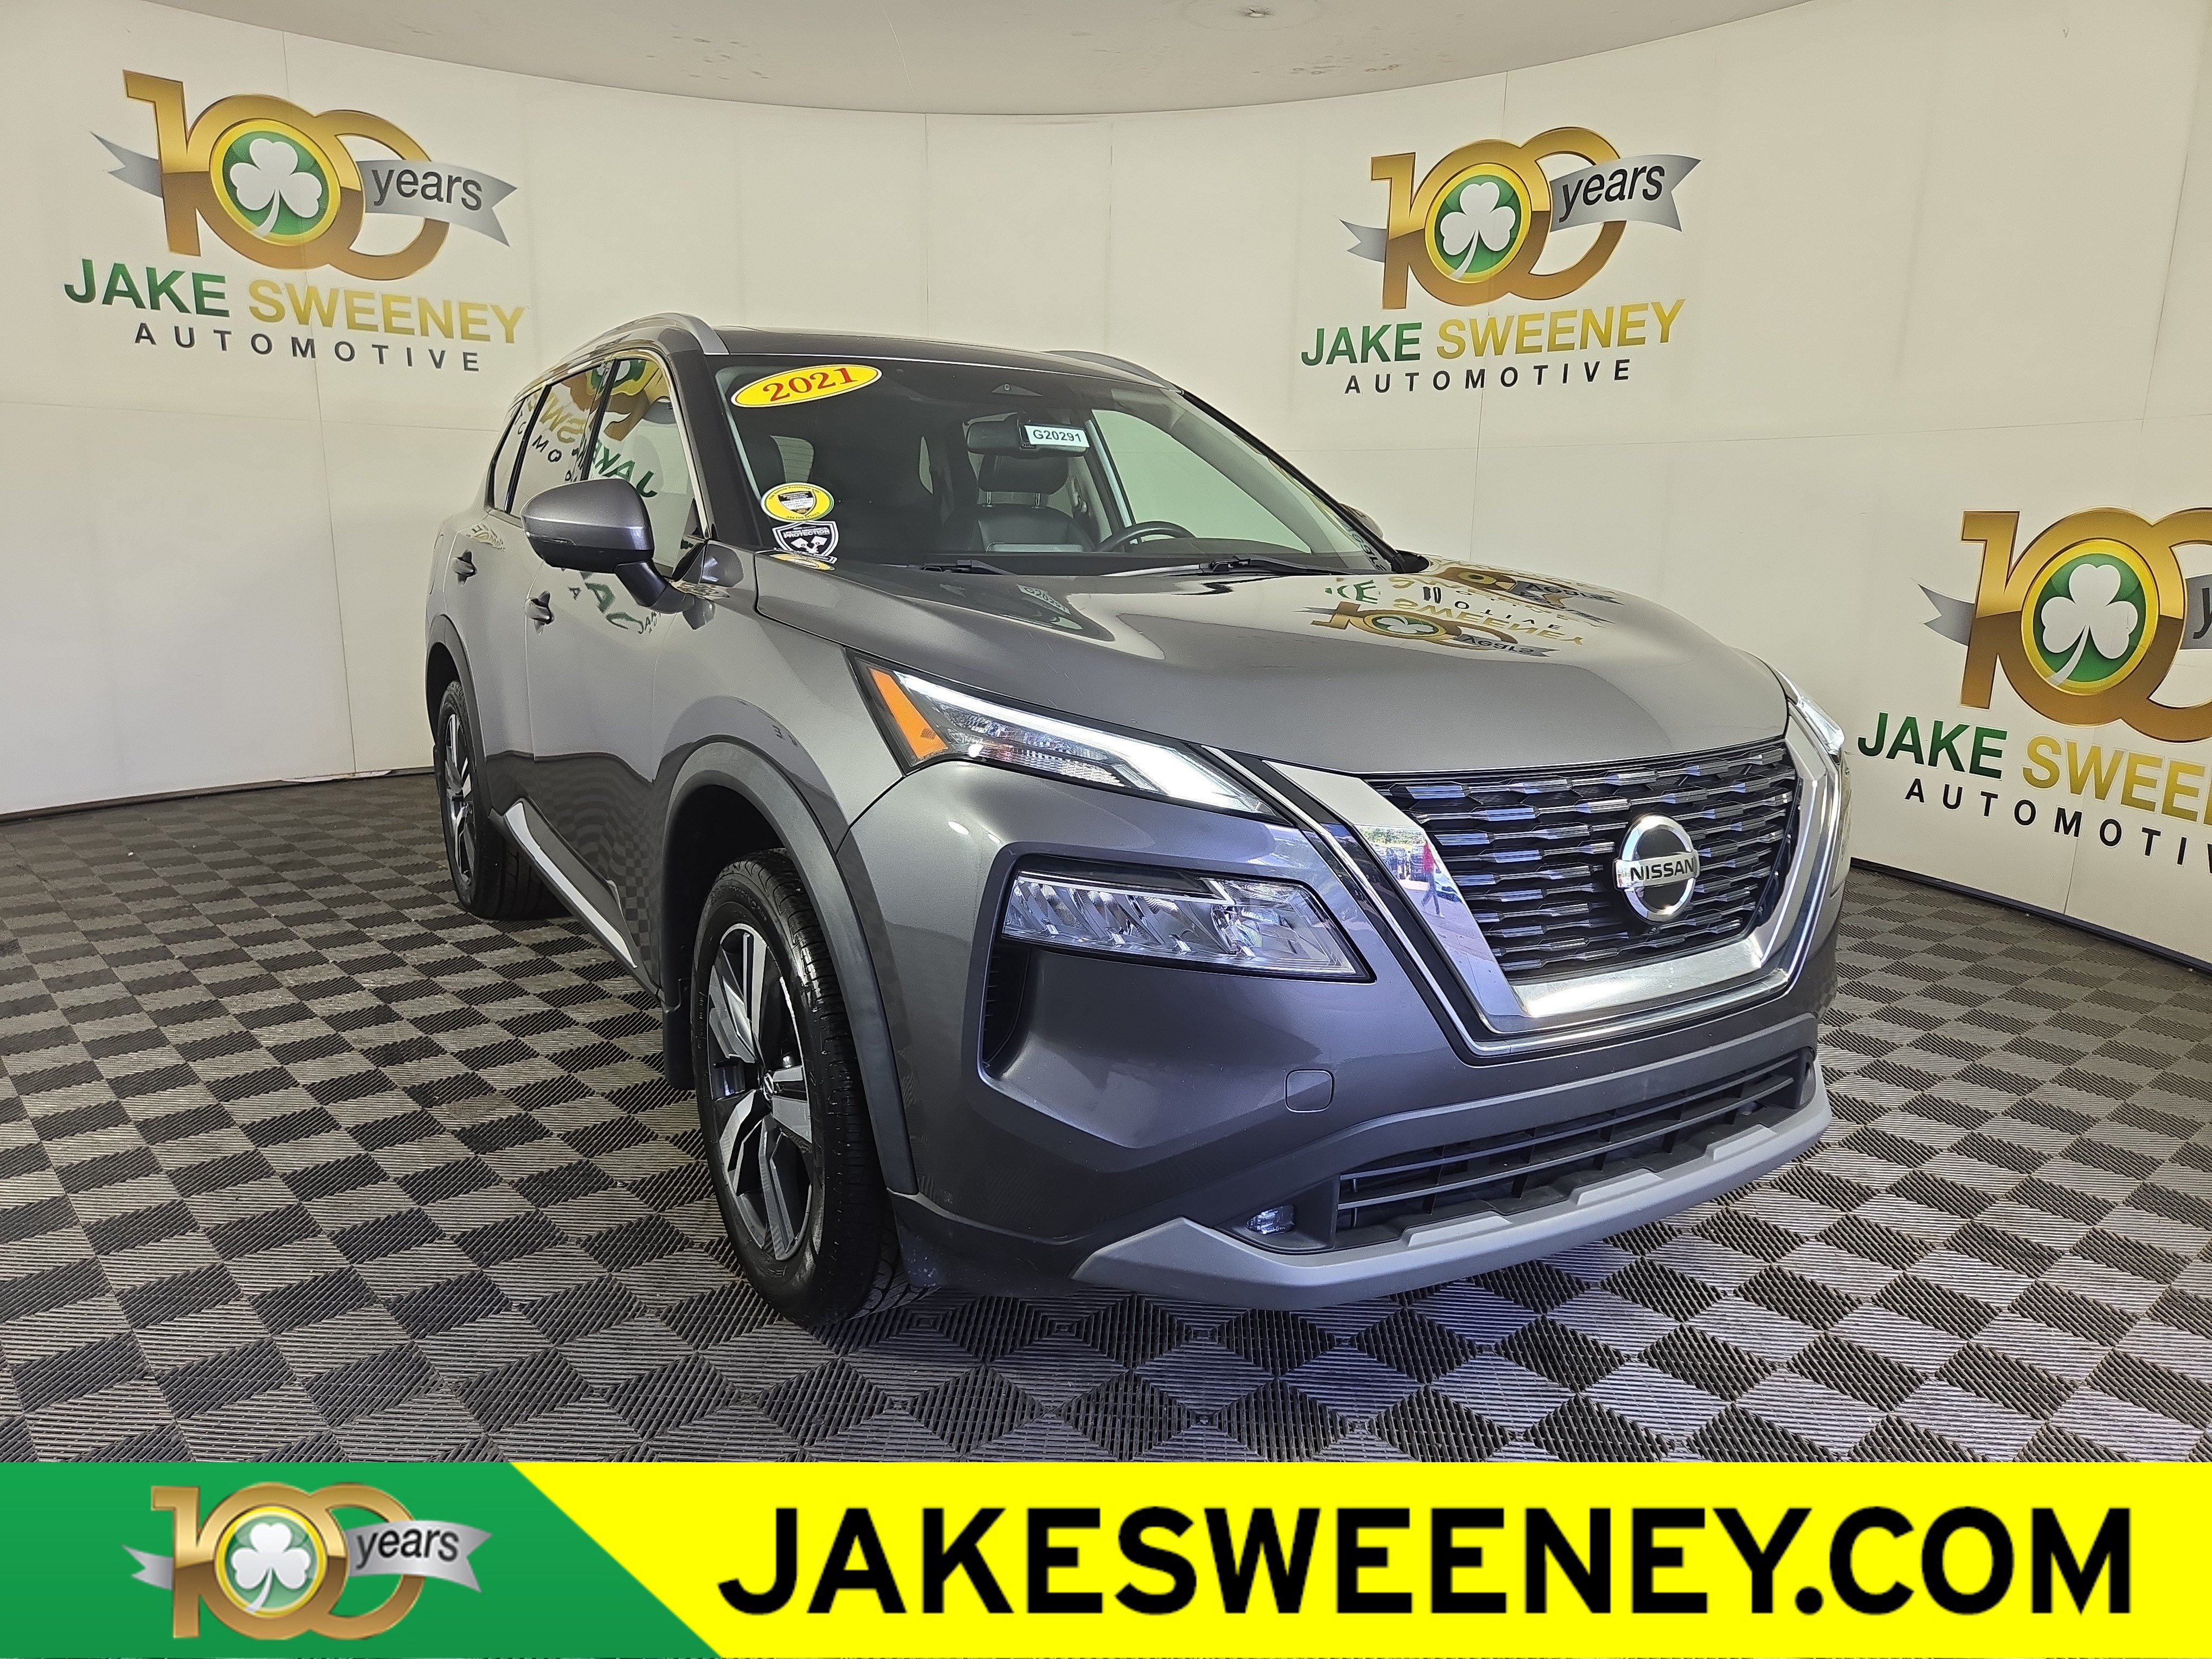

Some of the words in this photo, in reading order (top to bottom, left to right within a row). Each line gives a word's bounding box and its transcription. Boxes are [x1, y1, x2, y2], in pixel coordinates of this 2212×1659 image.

[123, 69, 451, 281] 100
[372, 168, 483, 211] years
[1559, 165, 1664, 222] years
[1371, 126, 1626, 309] 100
[64, 258, 230, 317] JAKE
[249, 279, 525, 344] SWEENEY
[134, 323, 479, 372] AUTOMOTIVE
[1301, 323, 1422, 366] JAKE
[1436, 299, 1685, 359] SWEENEY
[763, 367, 858, 402] 2021
[1345, 359, 1630, 395] AUTOMOTIVE
[1033, 429, 1081, 442] G20291
[1858, 712, 2008, 779] JAKE
[2022, 735, 2212, 826] SWEE
[1905, 778, 2212, 874] AUTOMOTI
[1631, 858, 1694, 881] NISSAN
